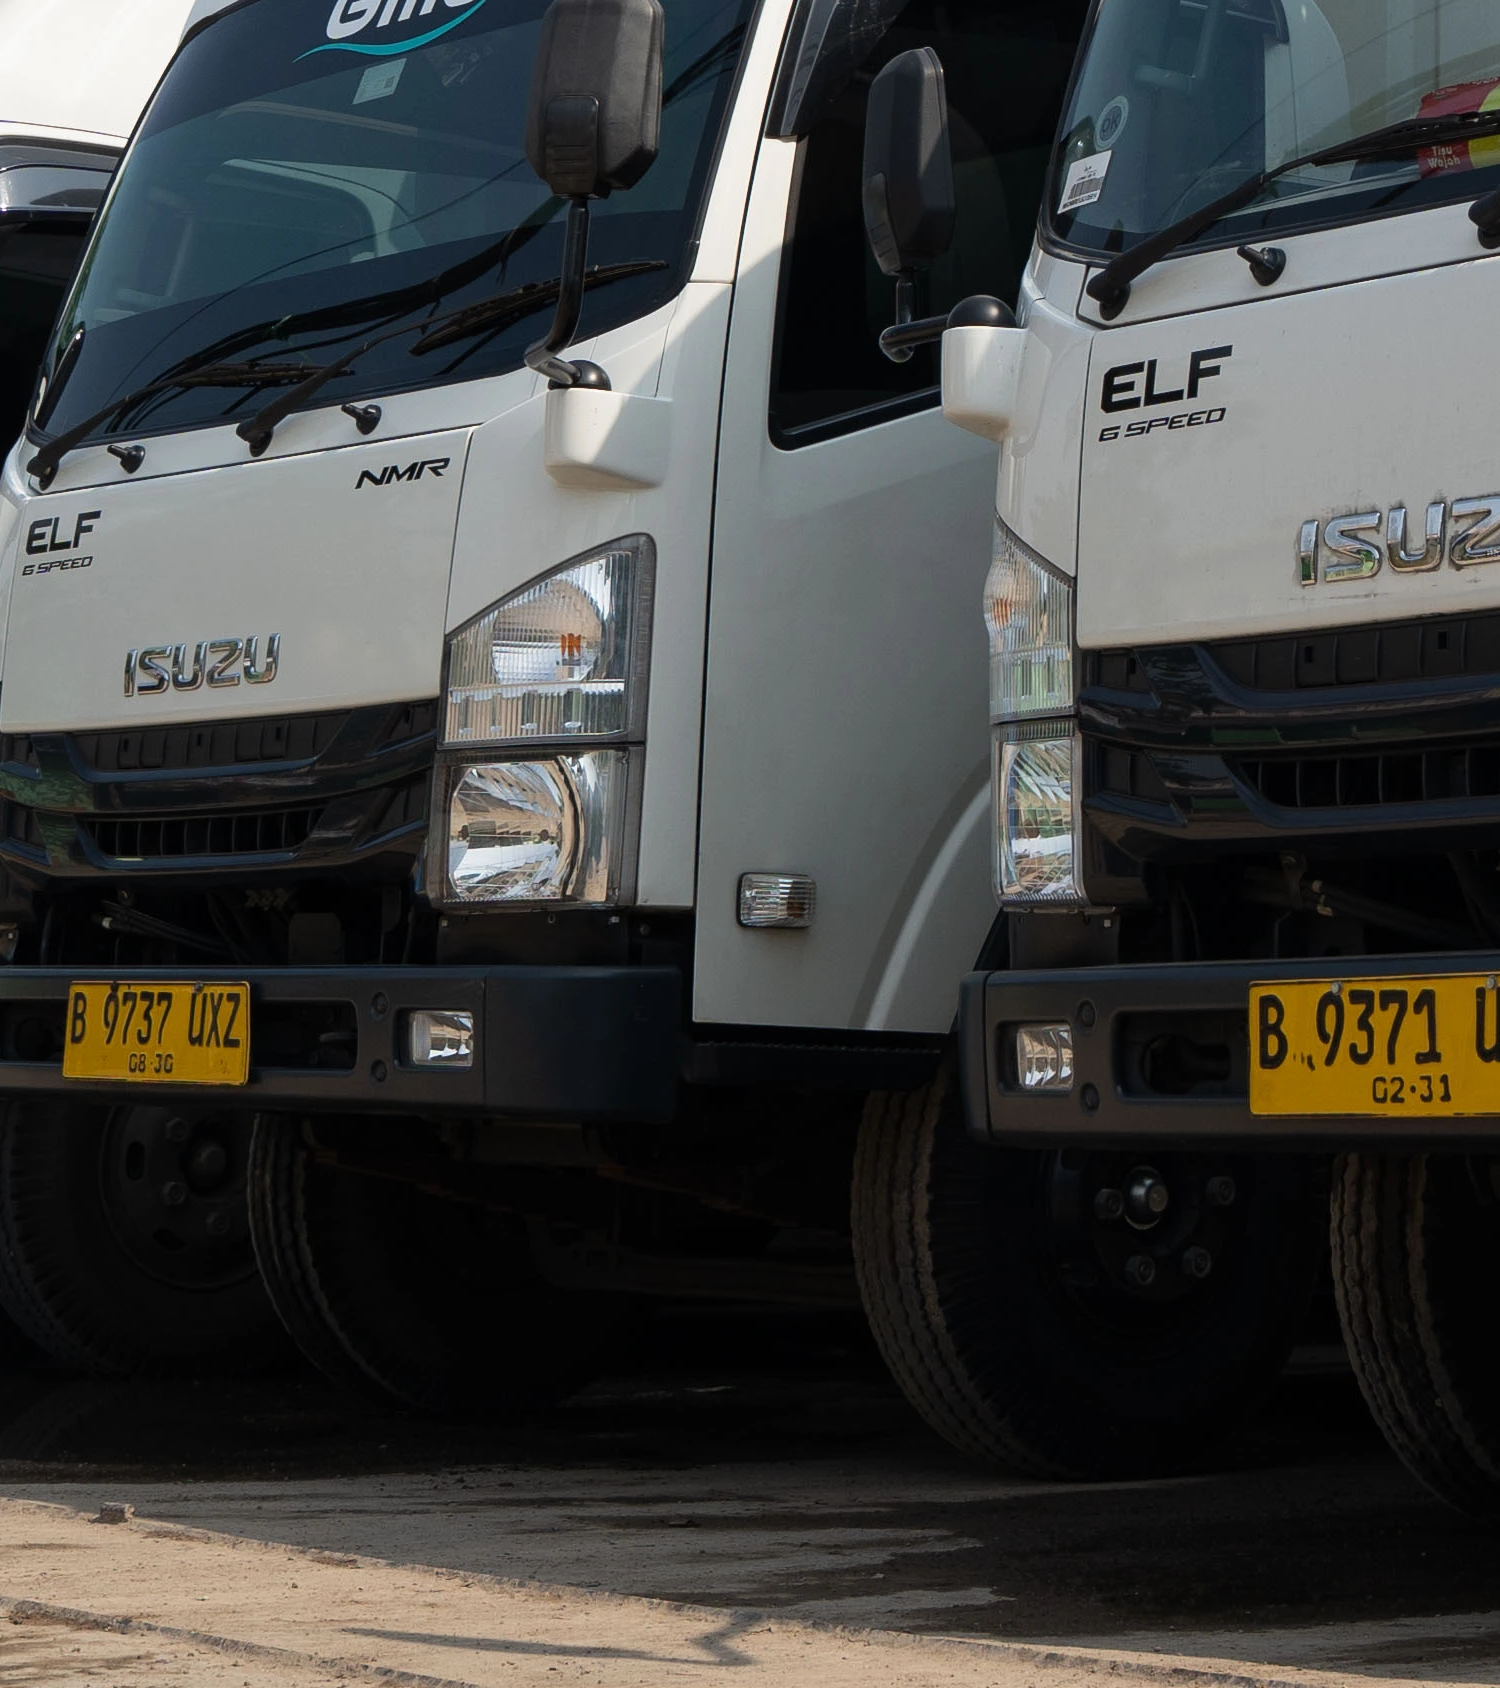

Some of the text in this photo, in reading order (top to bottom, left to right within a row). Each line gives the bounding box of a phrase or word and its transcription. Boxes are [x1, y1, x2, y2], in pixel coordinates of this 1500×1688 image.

[1102, 112, 1120, 132] OK
[1427, 155, 1460, 169] Wajah
[1431, 145, 1453, 158] Tisu
[1101, 344, 1233, 413] ELF
[1098, 407, 1227, 442] 6 SPEED
[354, 457, 451, 489] NMR
[26, 510, 102, 555] ELF
[22, 555, 94, 576] 6 SPEED
[124, 632, 281, 697] ISUZU
[71, 990, 241, 1048] B 9737 UXZ
[1259, 994, 1289, 1070] B
[1316, 987, 1442, 1067] 9371
